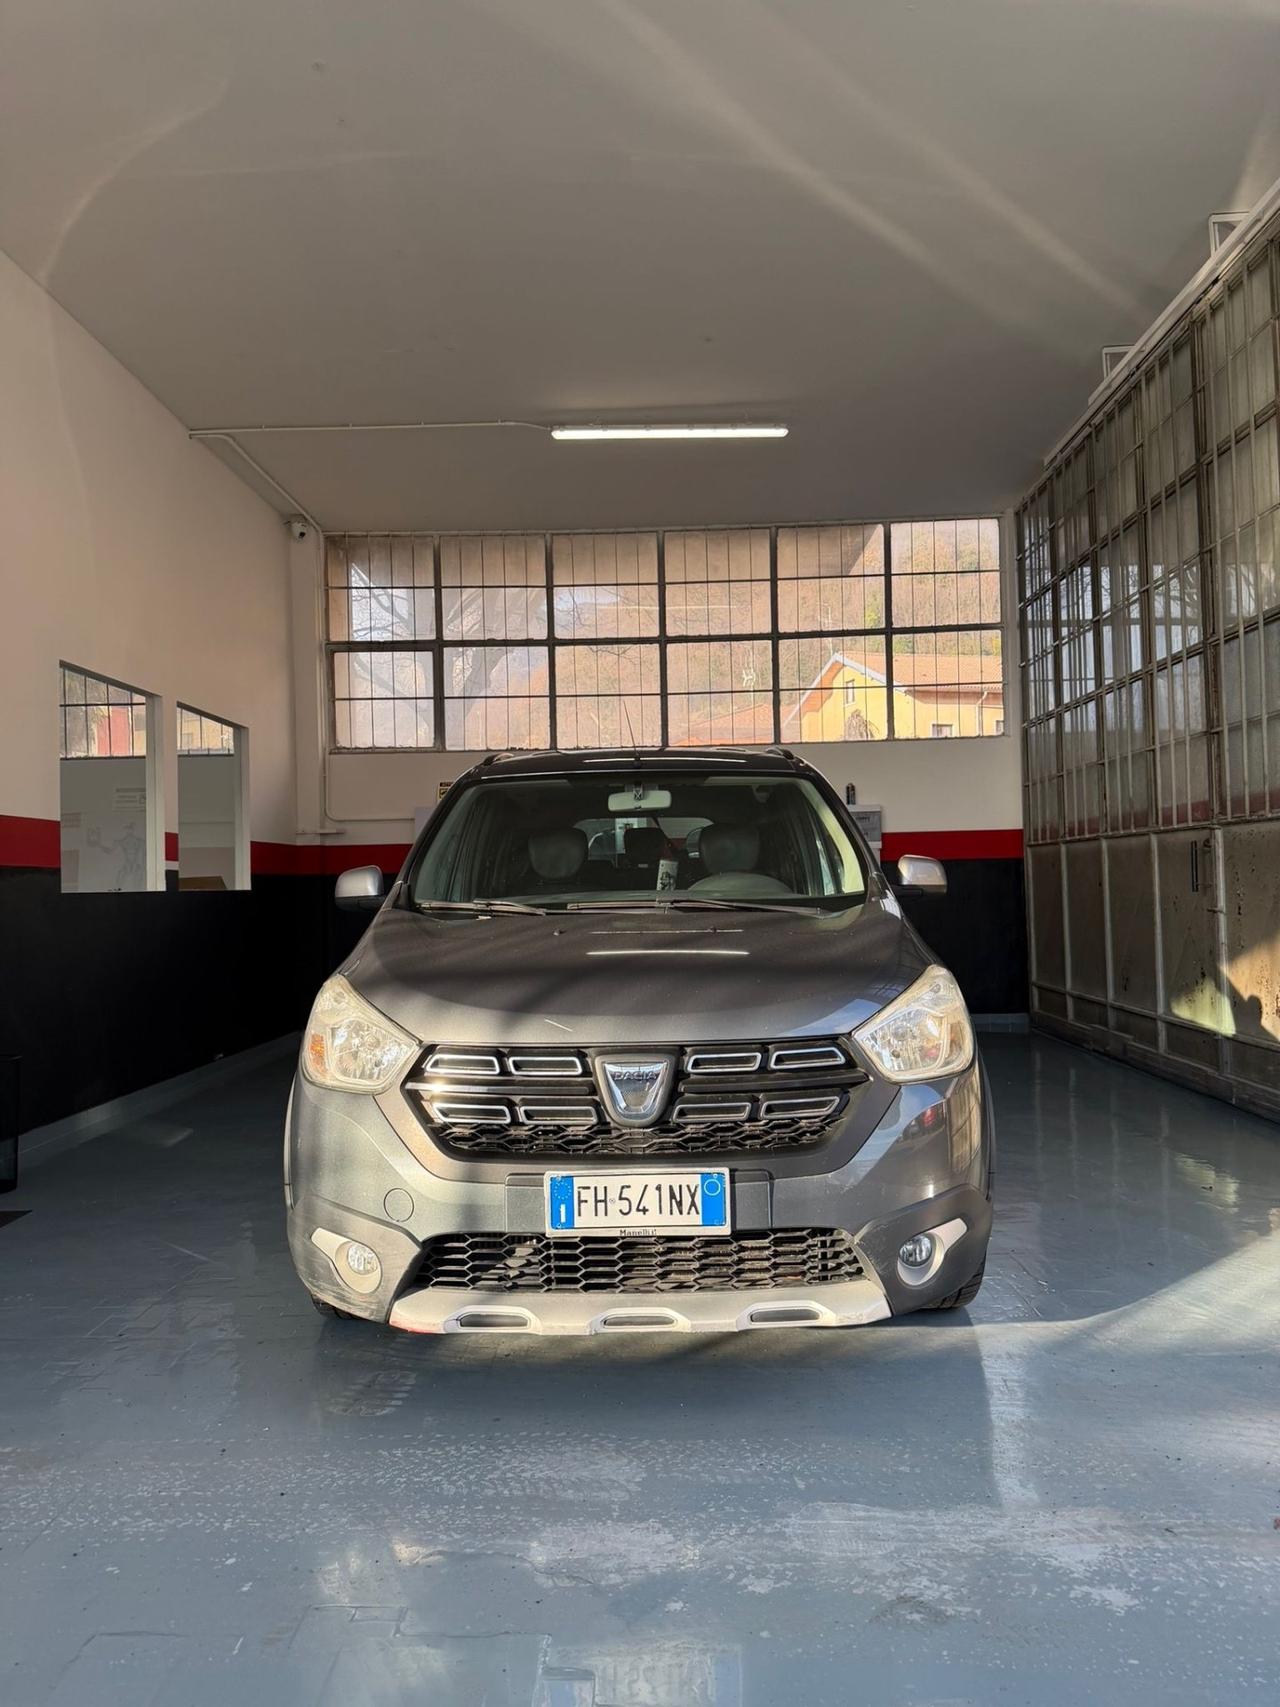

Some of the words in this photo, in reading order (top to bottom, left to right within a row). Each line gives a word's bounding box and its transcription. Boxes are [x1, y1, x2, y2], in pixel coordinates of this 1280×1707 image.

[613, 1070, 657, 1081] DACIA
[577, 1186, 608, 1217] FH
[618, 1184, 700, 1217] 541NX
